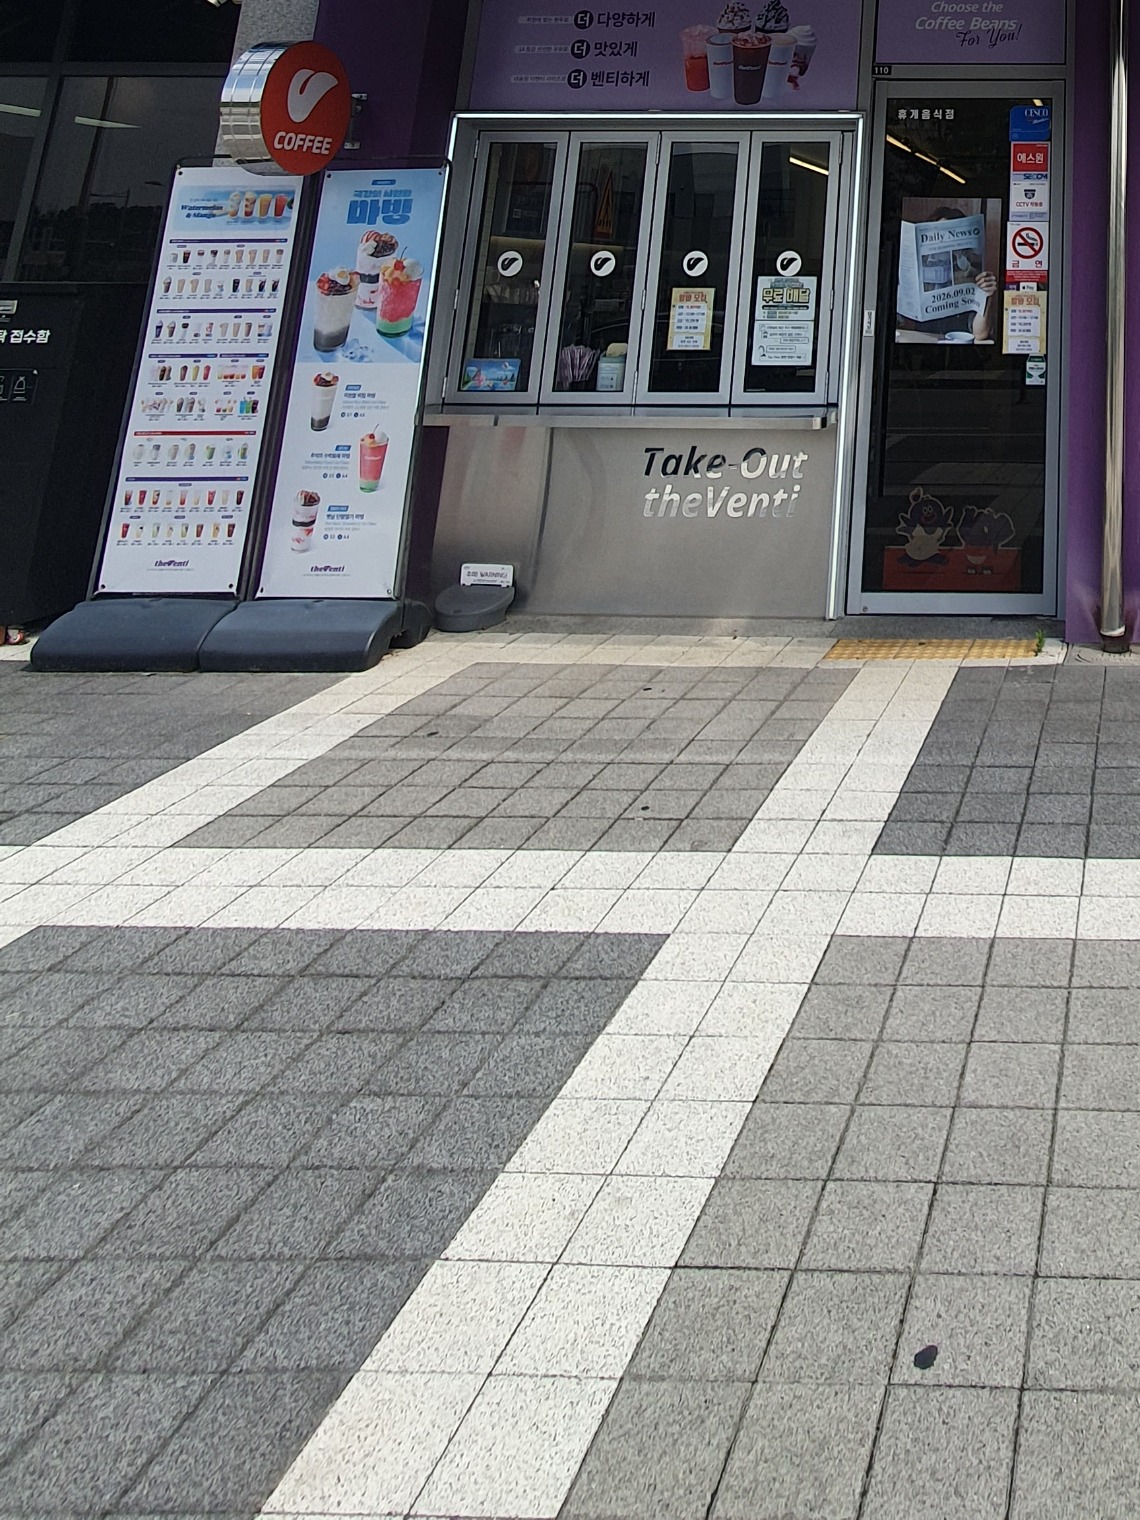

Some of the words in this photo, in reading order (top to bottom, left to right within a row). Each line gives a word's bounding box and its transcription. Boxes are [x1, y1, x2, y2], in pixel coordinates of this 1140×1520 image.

[931, 1, 979, 13] Choose
[981, 1, 1004, 13] the
[597, 11, 656, 29] 다양하게
[915, 16, 965, 30] Coffee
[969, 16, 1018, 30] Beans
[593, 40, 638, 58] 맛있게
[875, 66, 889, 74] 110
[590, 69, 650, 87] 벤티하게
[898, 109, 955, 120] 휴게음식점
[273, 131, 332, 155] COFFEE
[1017, 152, 1044, 164] 에스원
[920, 232, 945, 244] Daily
[948, 229, 973, 239] News
[762, 288, 784, 303] 무료
[785, 288, 811, 304] 배달
[924, 301, 960, 314] Coming
[9, 329, 51, 344] 접수함
[644, 446, 808, 478] Take-Out
[643, 484, 801, 518] theVenti
